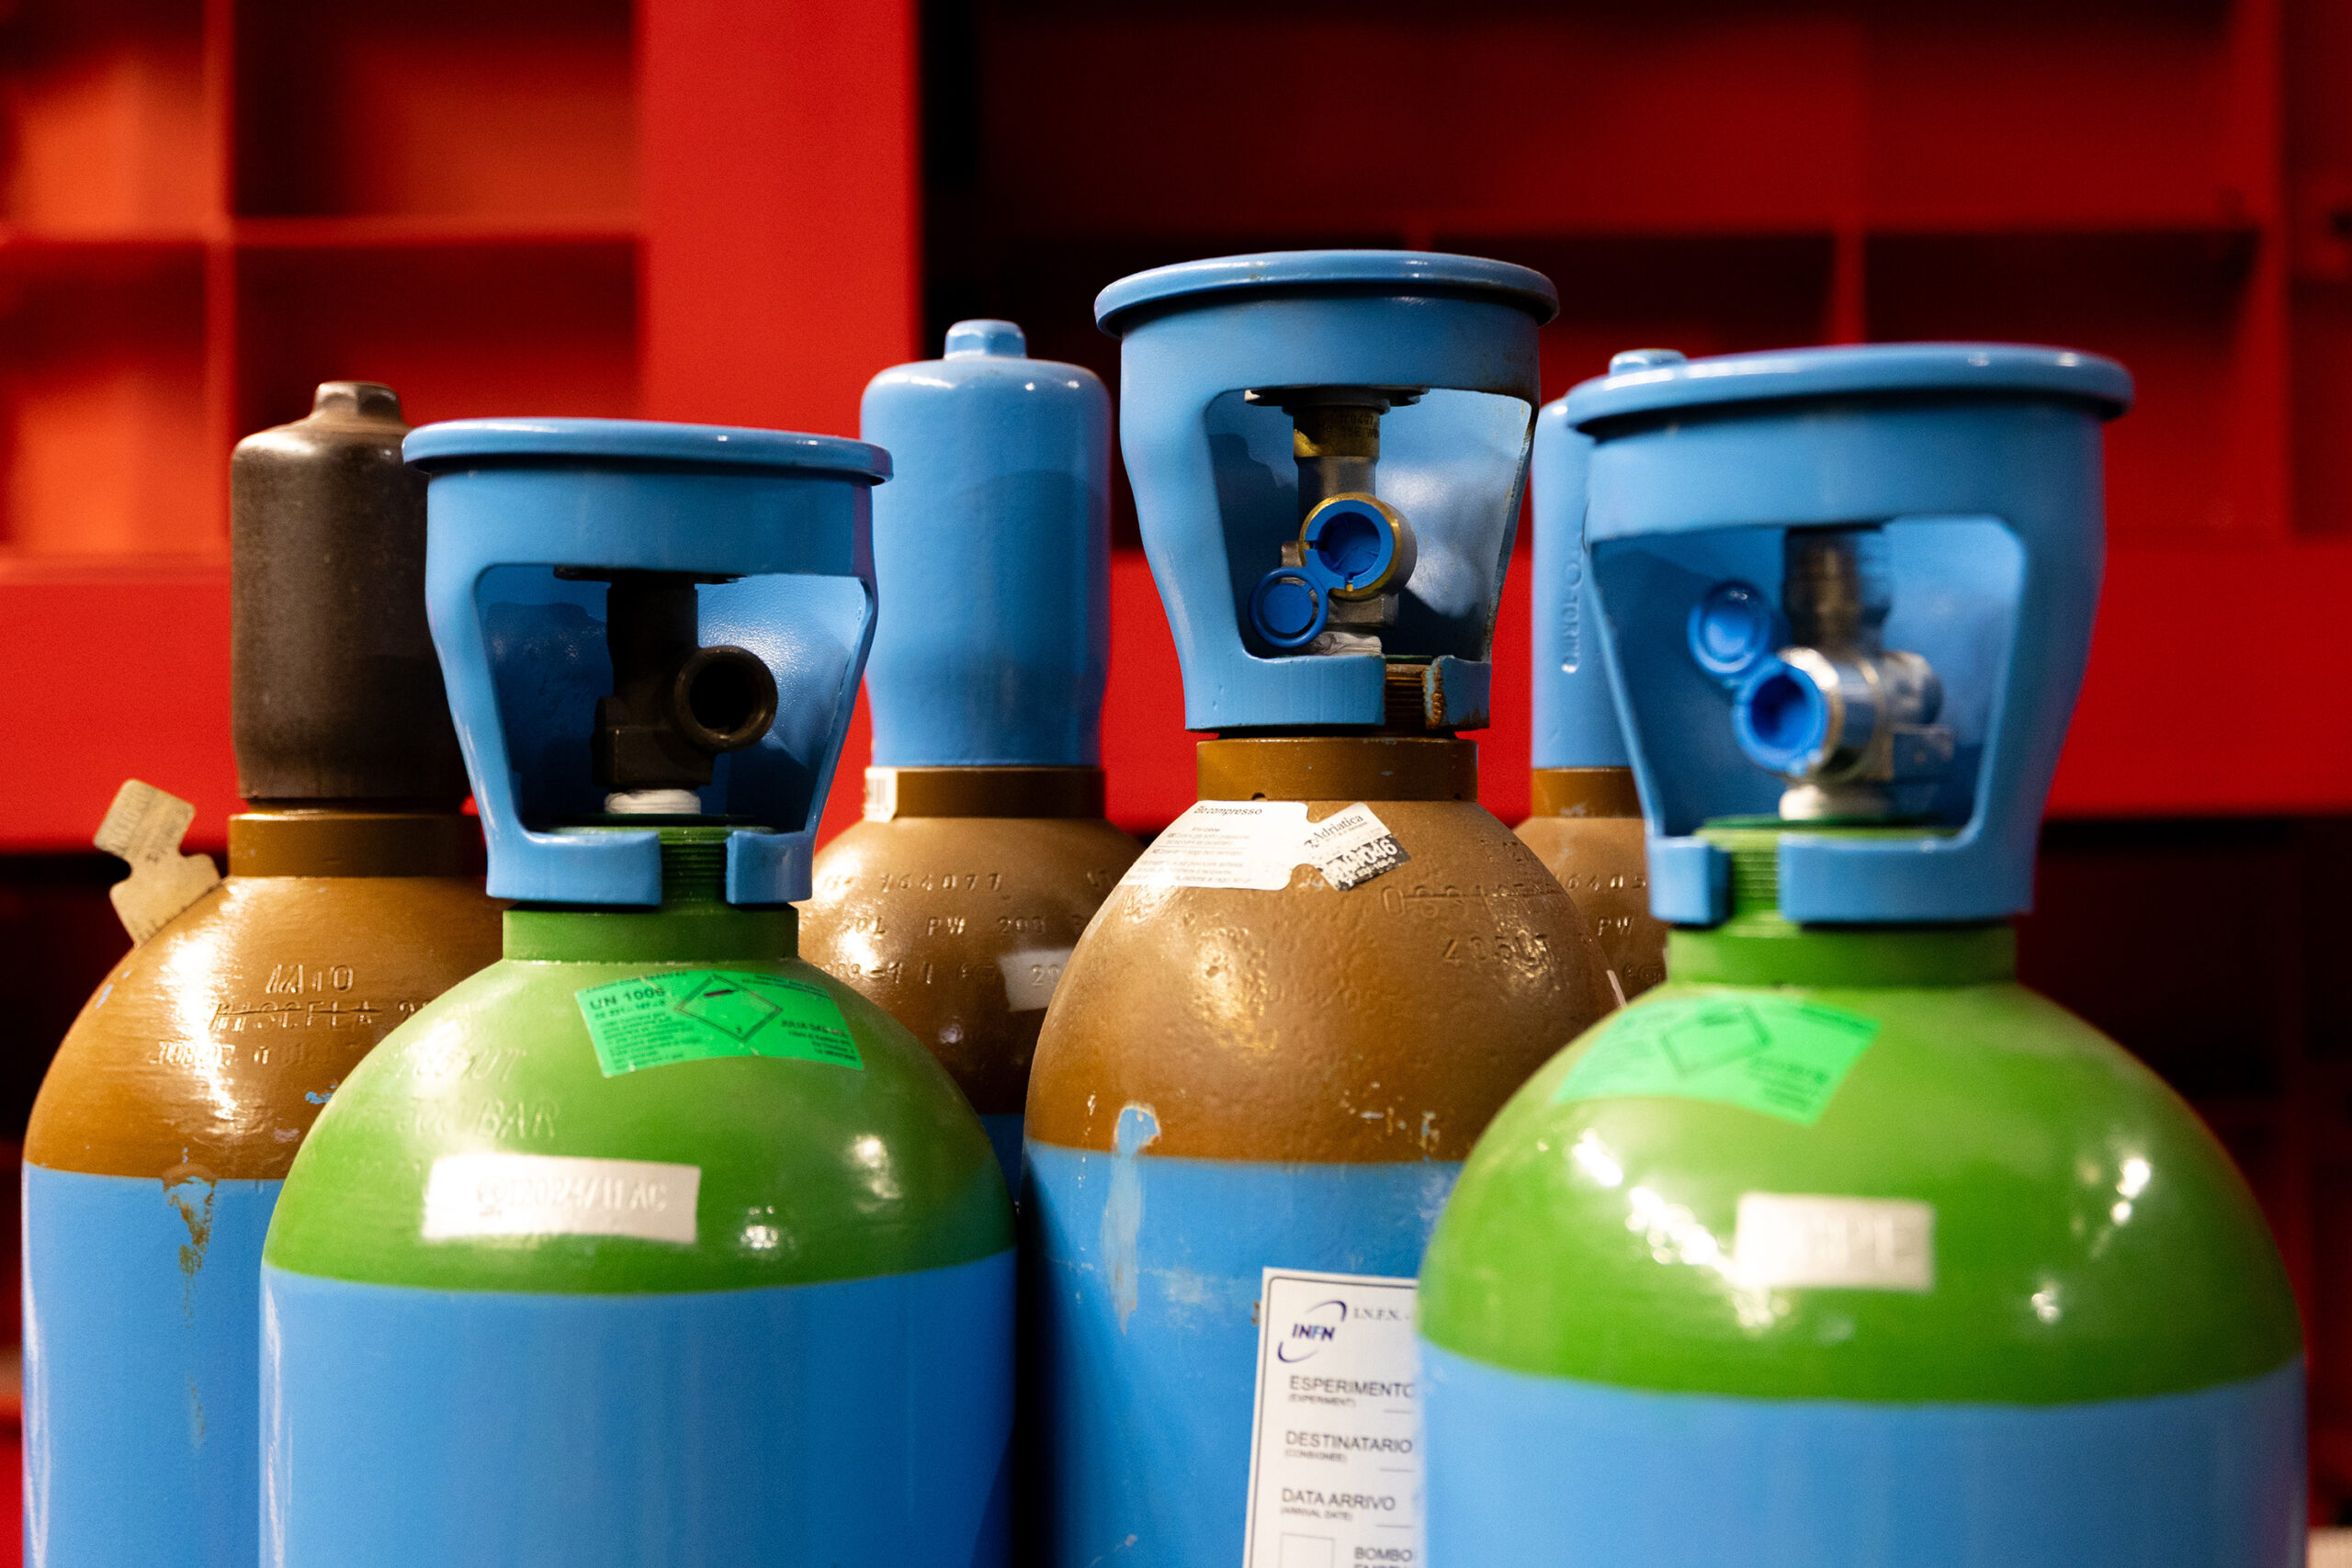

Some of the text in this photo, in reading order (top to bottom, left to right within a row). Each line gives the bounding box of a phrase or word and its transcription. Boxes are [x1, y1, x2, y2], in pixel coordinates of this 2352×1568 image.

[1207, 807, 1262, 817] compresso
[1314, 815, 1364, 840] Adriatica
[590, 996, 616, 1010] UN
[1292, 1323, 1336, 1341] INFN
[1285, 1430, 1413, 1454] DESTINATARIO
[1282, 1488, 1396, 1512] DATA ARRIVO
